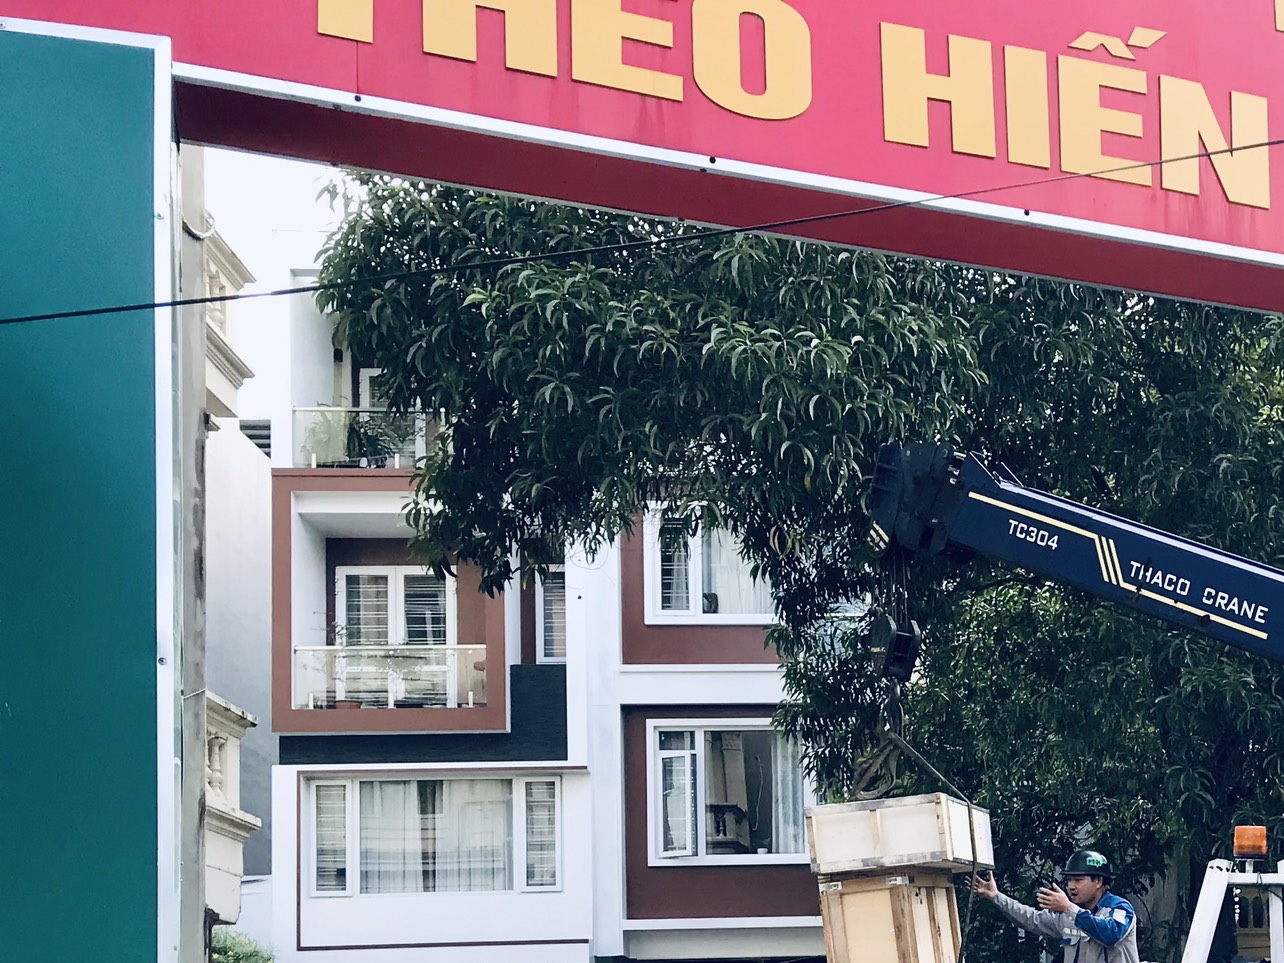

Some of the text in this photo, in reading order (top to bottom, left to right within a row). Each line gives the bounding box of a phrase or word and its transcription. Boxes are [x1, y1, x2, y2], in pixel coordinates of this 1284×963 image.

[879, 21, 1271, 210] HIẾN
[1008, 519, 1059, 551] TC304
[1130, 560, 1269, 624] THACO CRANE
